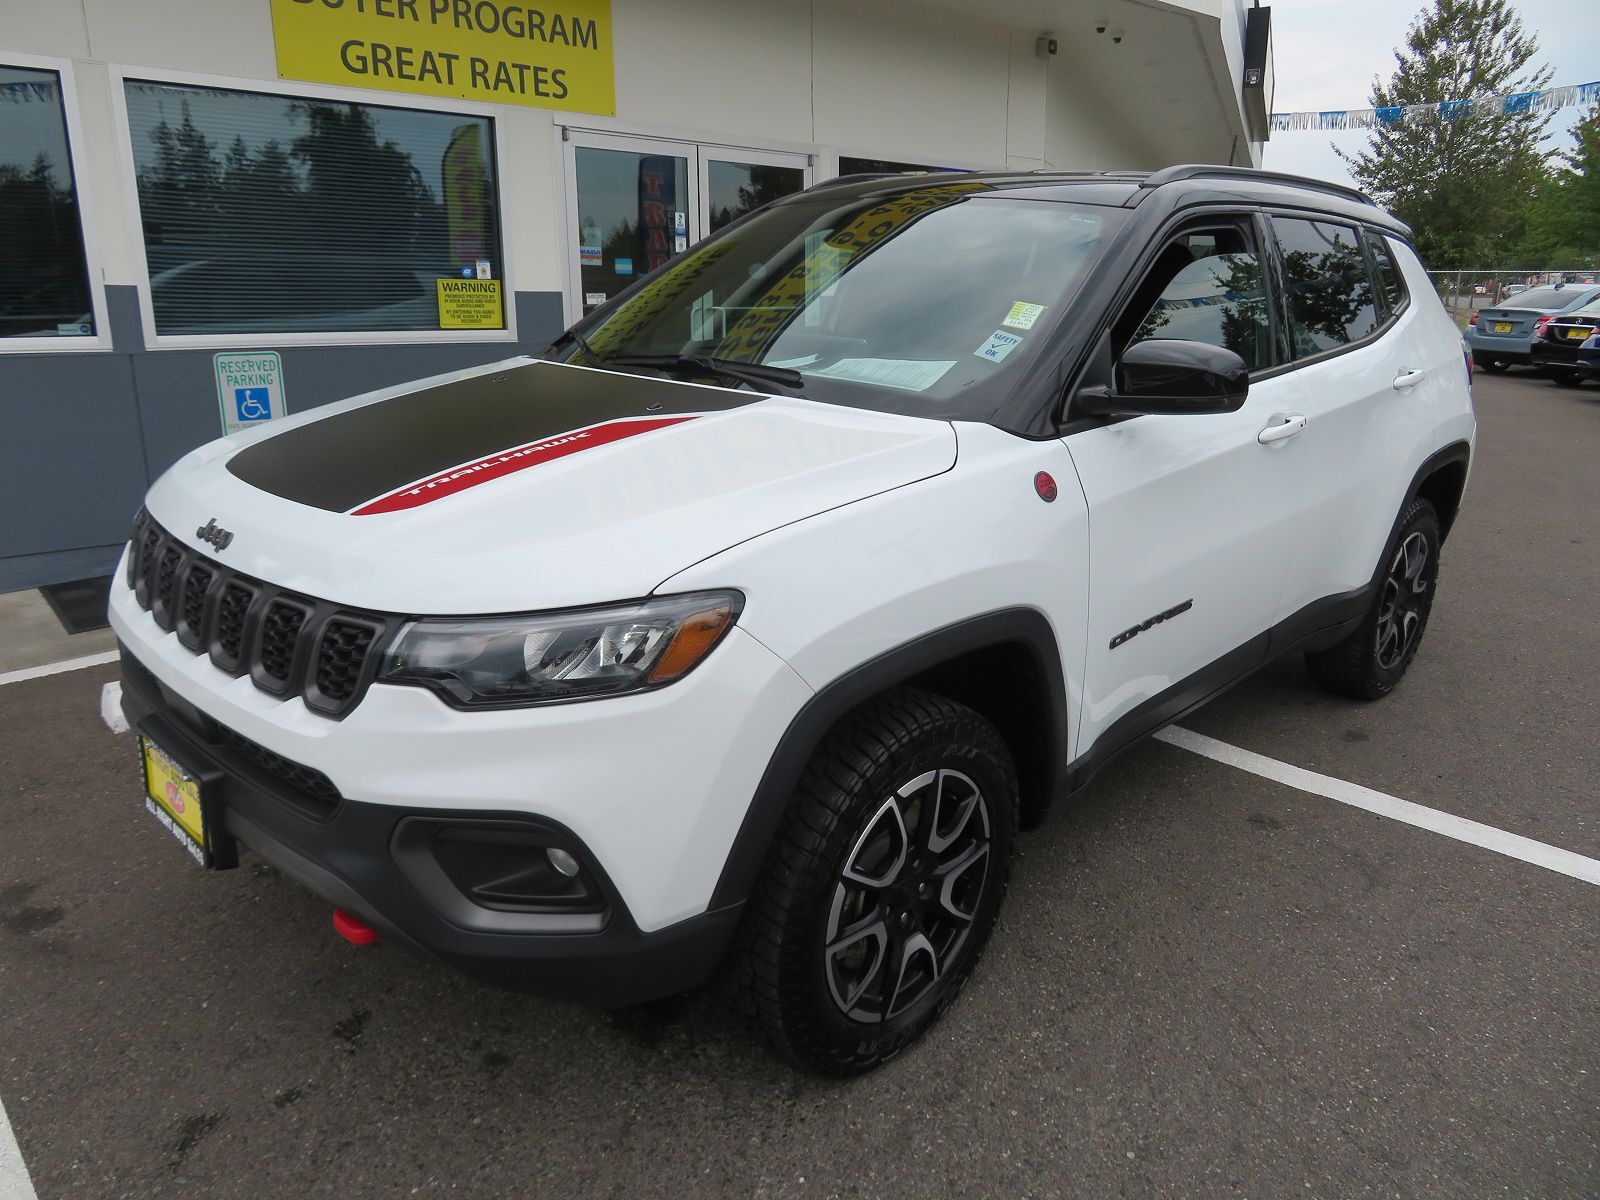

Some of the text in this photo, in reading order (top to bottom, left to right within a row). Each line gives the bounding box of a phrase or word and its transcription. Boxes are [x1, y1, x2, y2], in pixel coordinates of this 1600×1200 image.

[430, 0, 598, 50] PROGRAM
[340, 39, 568, 99] GREAT RATES
[442, 282, 496, 293] WARNING
[993, 333, 1018, 345] SAFETY
[985, 349, 999, 357] OK
[220, 360, 276, 374] RESERVED
[226, 374, 274, 386] PARKING
[399, 432, 593, 497] TRAILHAWK
[196, 517, 234, 554] Jeep
